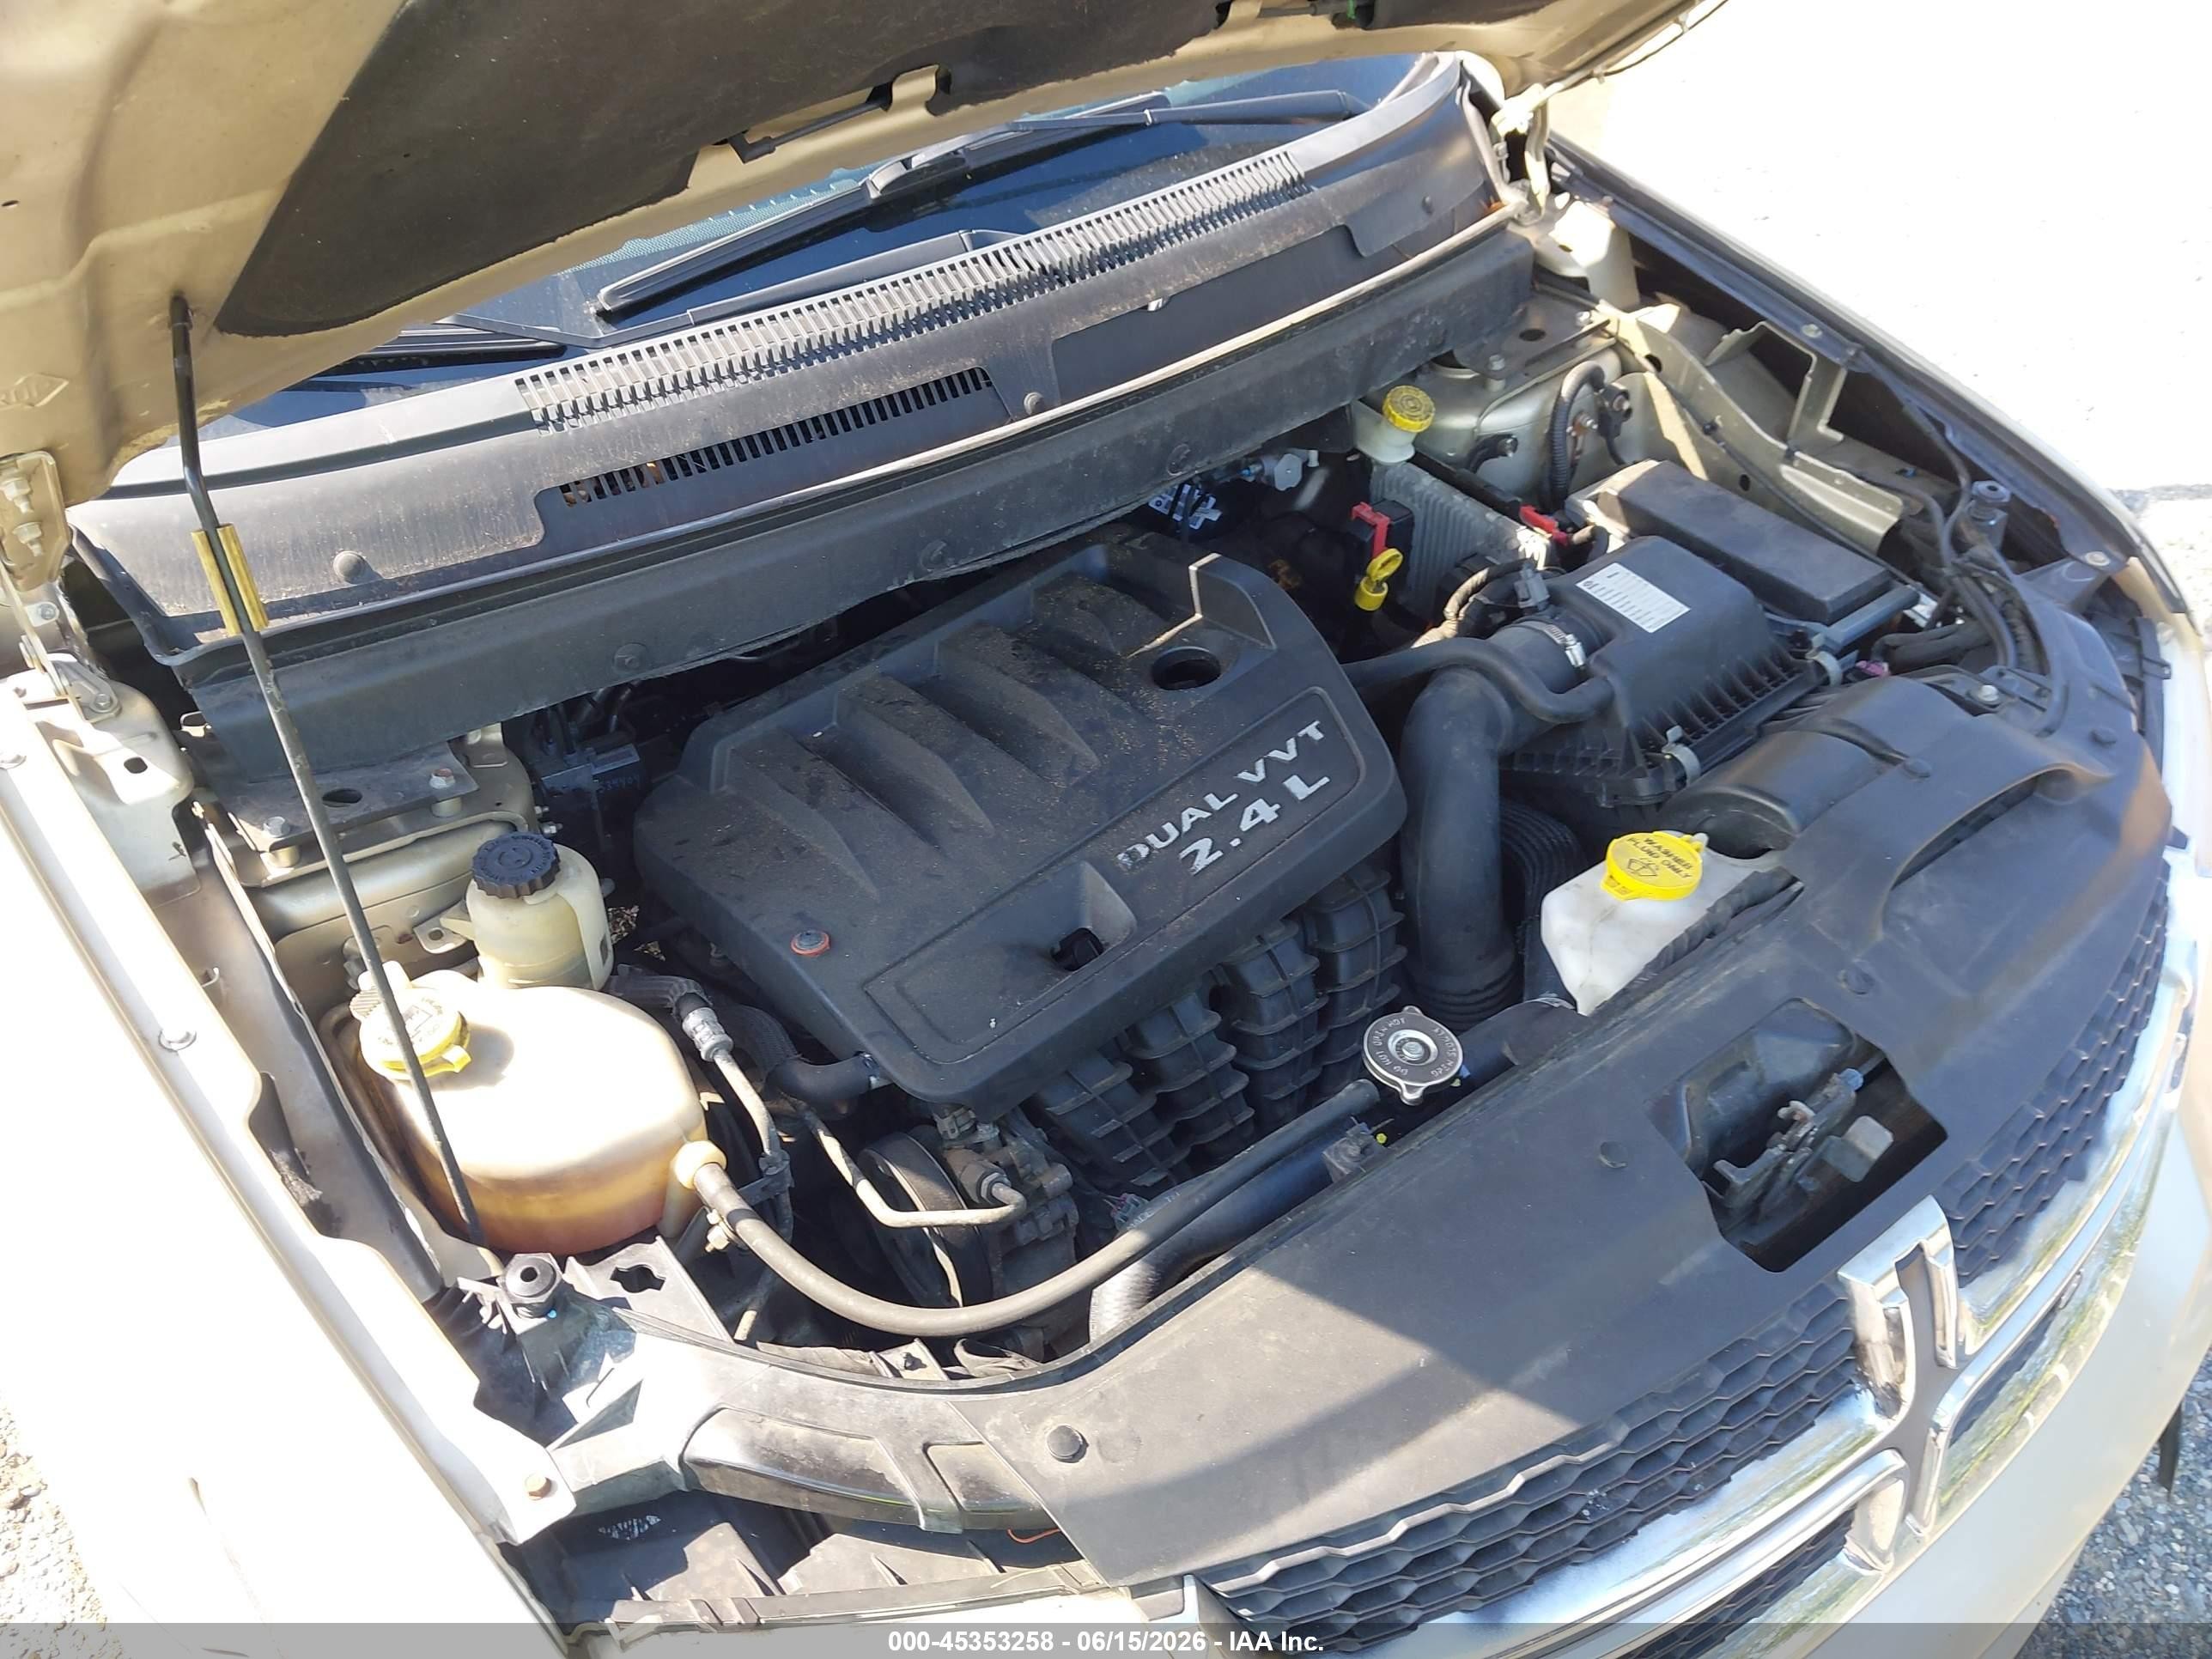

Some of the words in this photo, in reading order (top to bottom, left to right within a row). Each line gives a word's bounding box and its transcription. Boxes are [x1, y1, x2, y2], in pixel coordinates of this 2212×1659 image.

[1116, 793, 1238, 866] DUAL
[1234, 720, 1325, 783] VVT
[1626, 837, 1660, 859] FLUID
[1661, 859, 1693, 878] ONLY
[1644, 837, 1693, 870] WASHER
